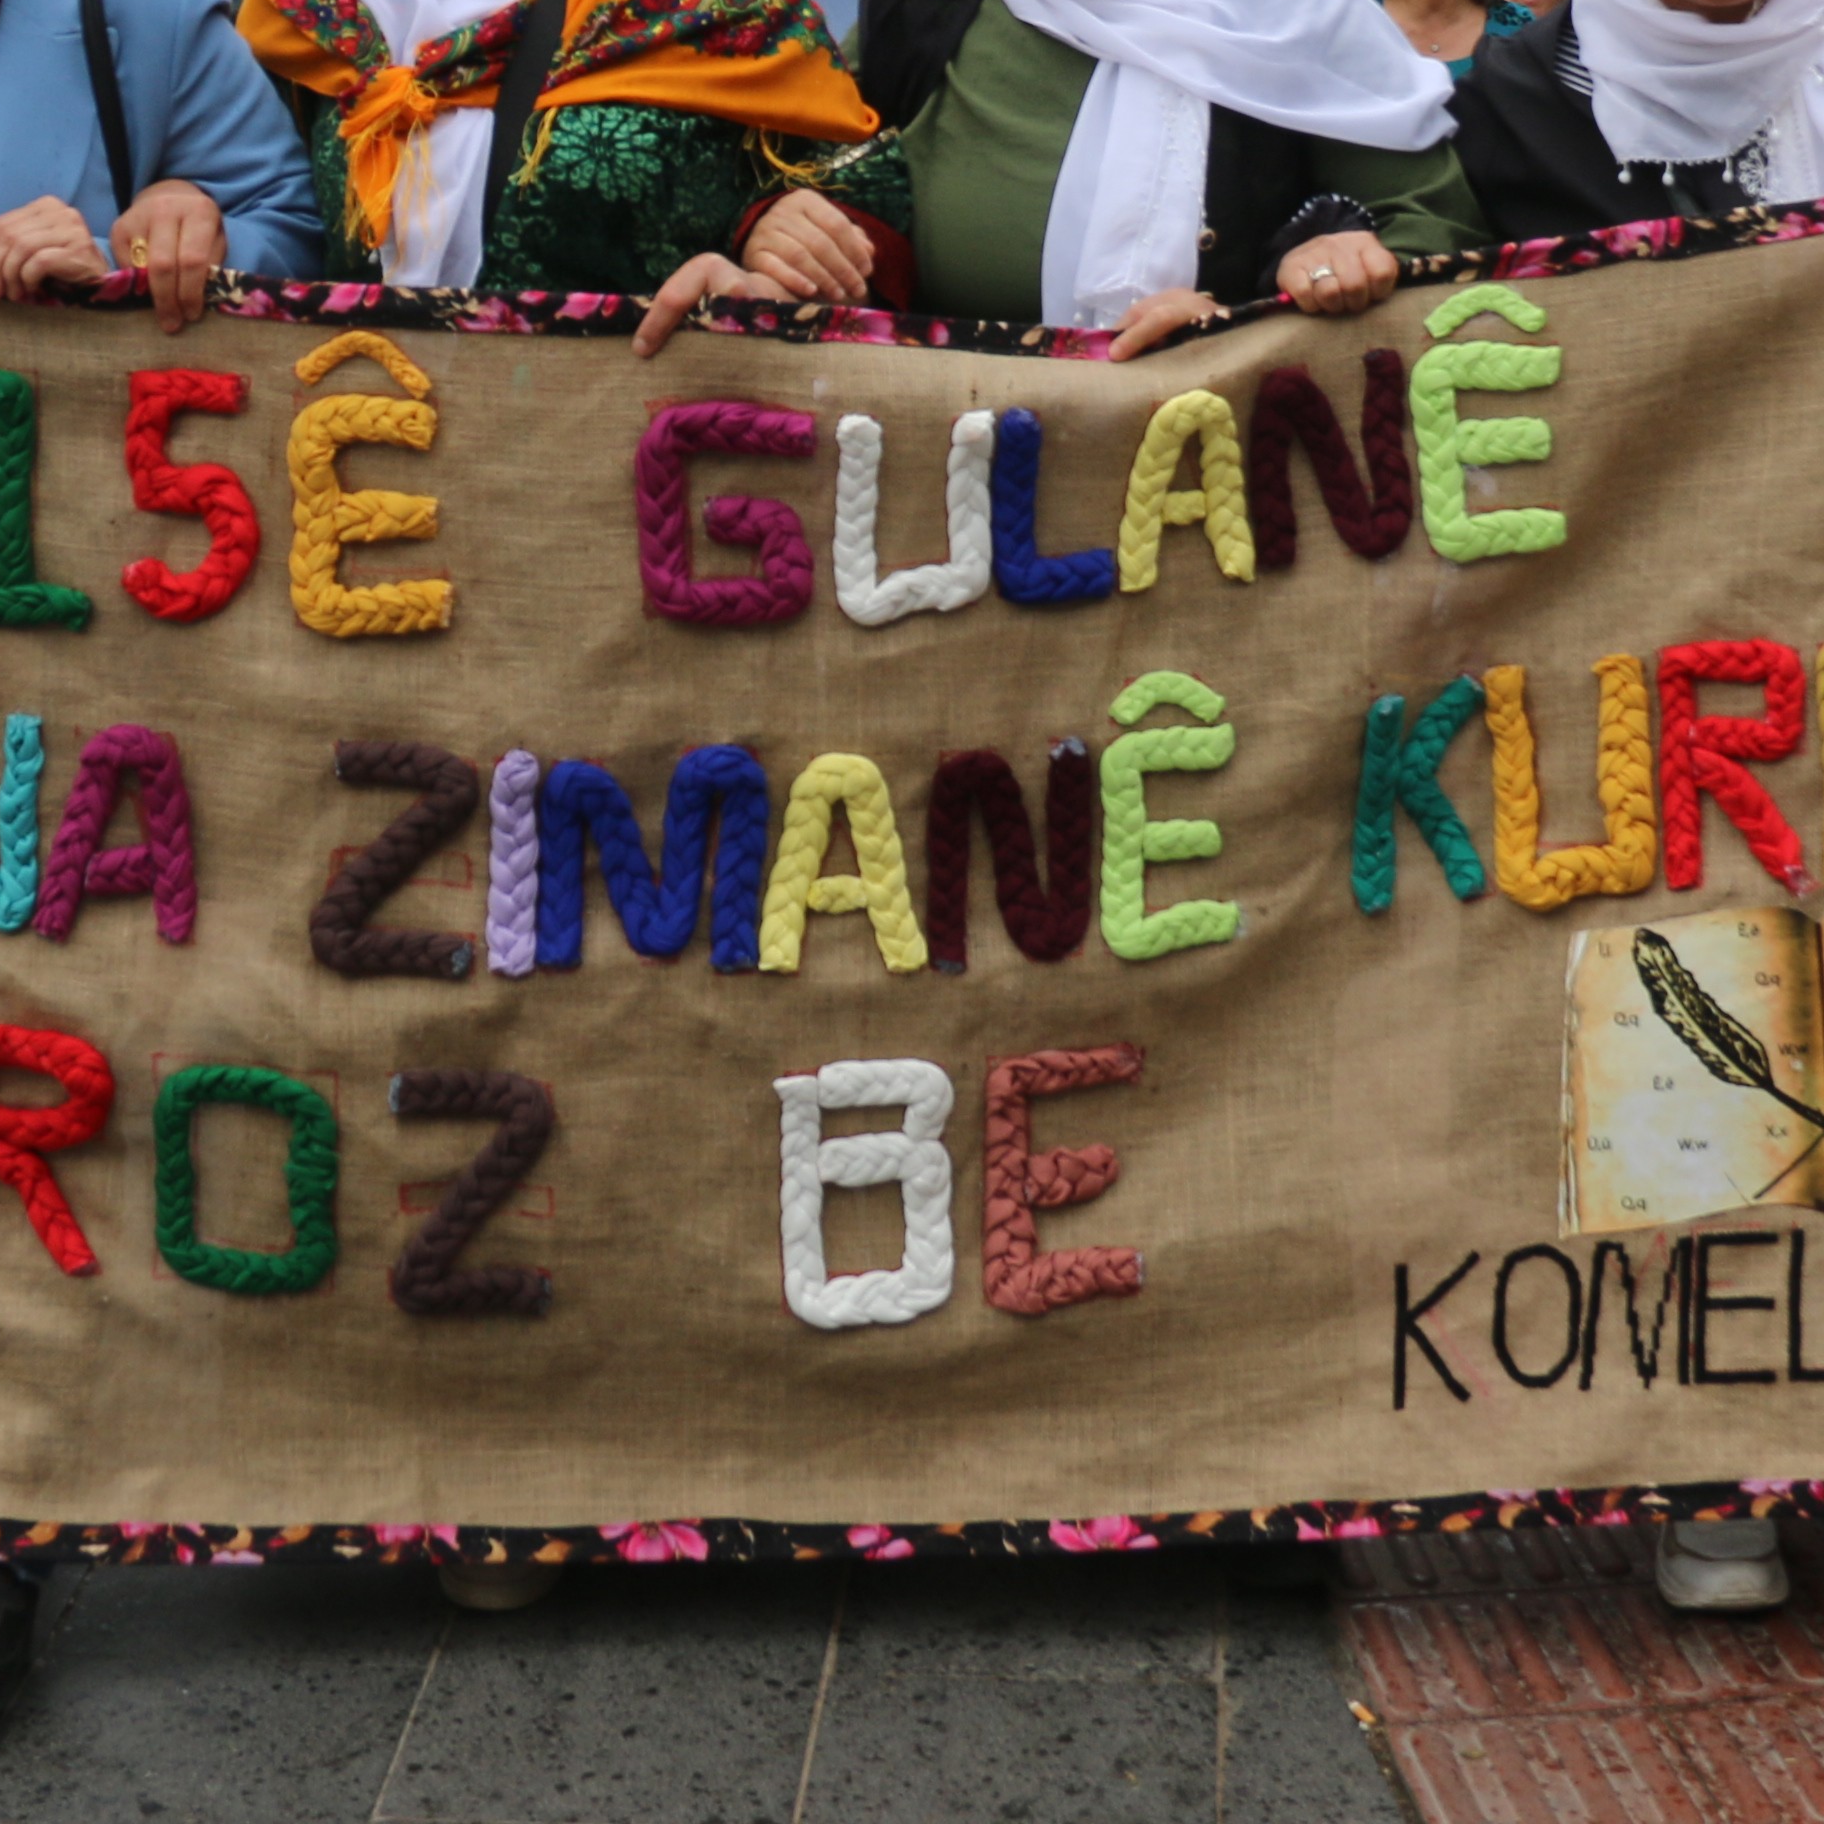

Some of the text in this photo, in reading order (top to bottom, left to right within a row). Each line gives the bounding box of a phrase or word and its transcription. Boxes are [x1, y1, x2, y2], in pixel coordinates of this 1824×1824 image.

[634, 284, 1567, 626] GULANÊ
[310, 668, 1245, 974] ZIMANÊ
[773, 1042, 1145, 1329] BE
